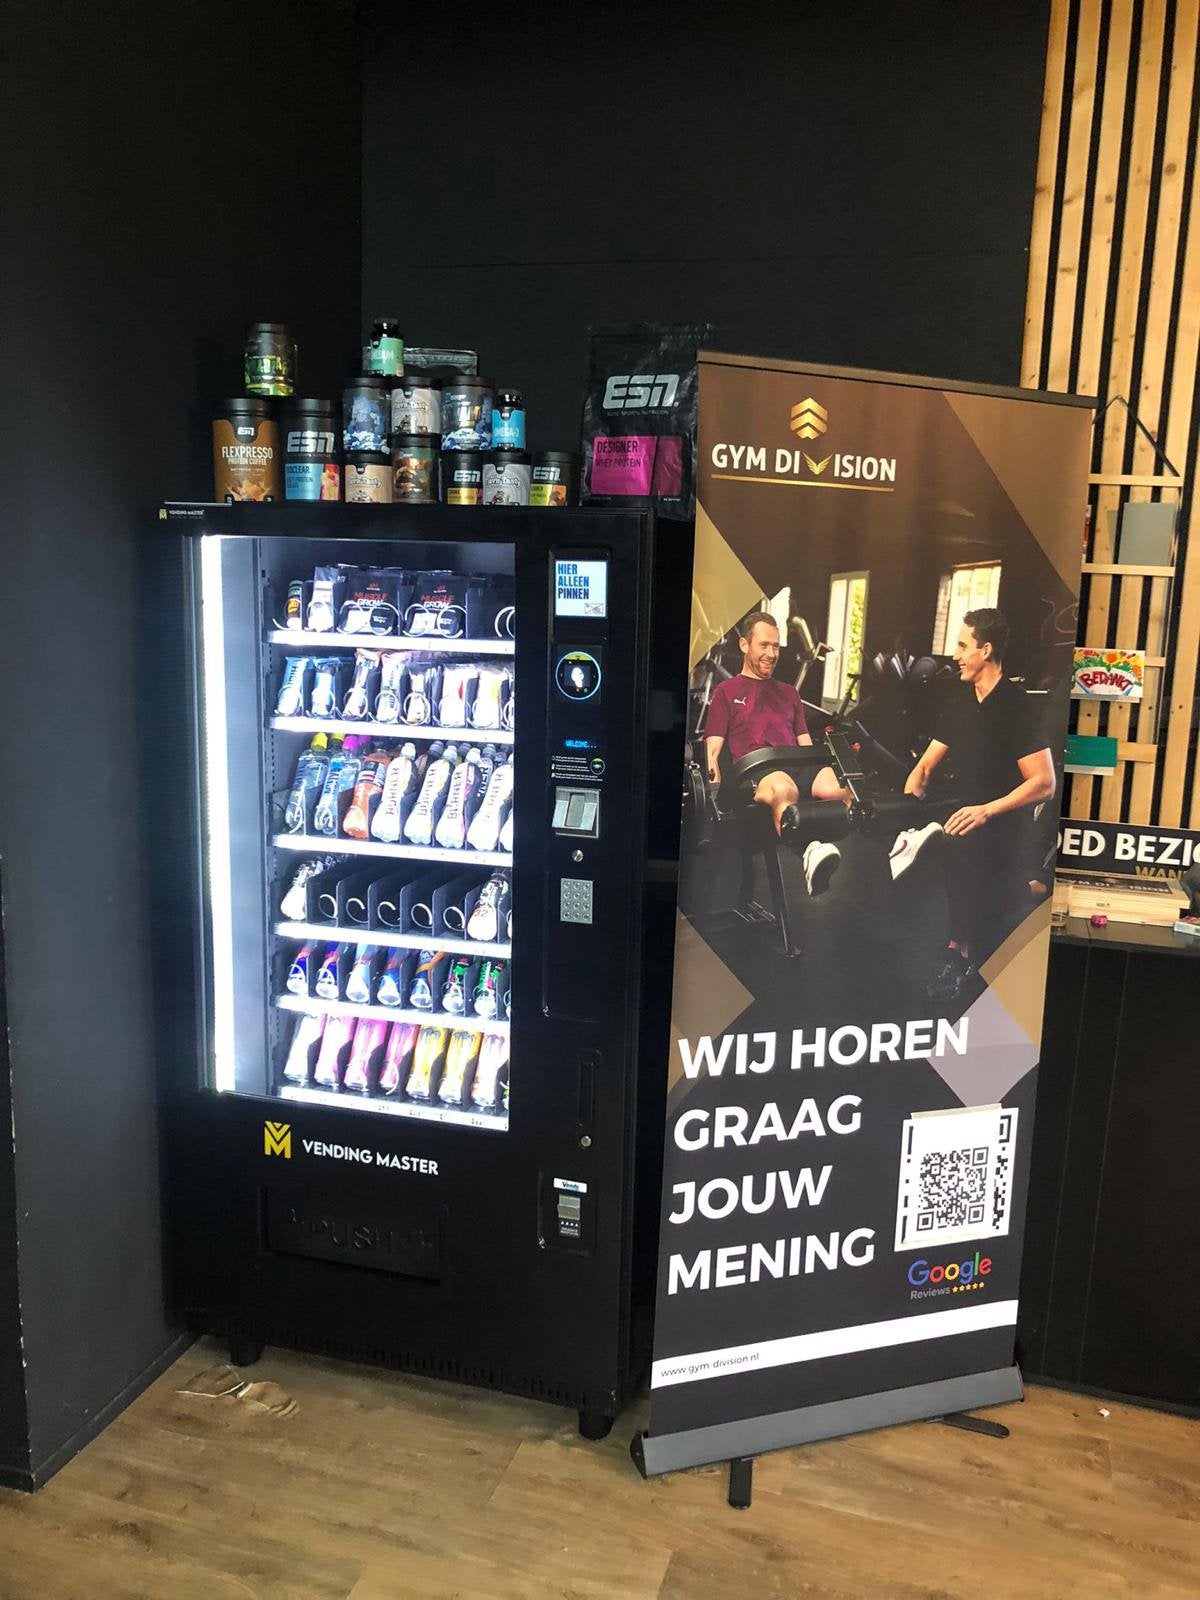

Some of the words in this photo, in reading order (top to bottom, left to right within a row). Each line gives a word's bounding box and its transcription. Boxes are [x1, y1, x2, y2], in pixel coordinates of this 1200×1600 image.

[603, 374, 680, 409] ESN
[222, 446, 274, 459] FLEXPRESSO
[287, 431, 335, 453] ESN
[596, 440, 639, 453] DESIGNER
[614, 458, 641, 468] PROTEIN
[711, 443, 767, 471] GYM
[453, 470, 480, 482] ESN
[533, 467, 560, 481] ESN
[557, 563, 578, 575] HIER
[558, 575, 590, 587] ALLEEN
[557, 587, 590, 600] PINNEN
[1078, 670, 1134, 692] BEDANKT
[1056, 827, 1106, 858] ED
[677, 1031, 777, 1080] WIJ
[790, 1016, 970, 1070] HOREN
[673, 1094, 863, 1152] GRAAG
[302, 1139, 373, 1164] VENDING
[375, 1152, 439, 1176] MASTER
[668, 1165, 833, 1225] JOUW
[667, 1227, 876, 1296] MENING
[907, 1251, 993, 1286] Google
[910, 1286, 951, 1300] Reviews
